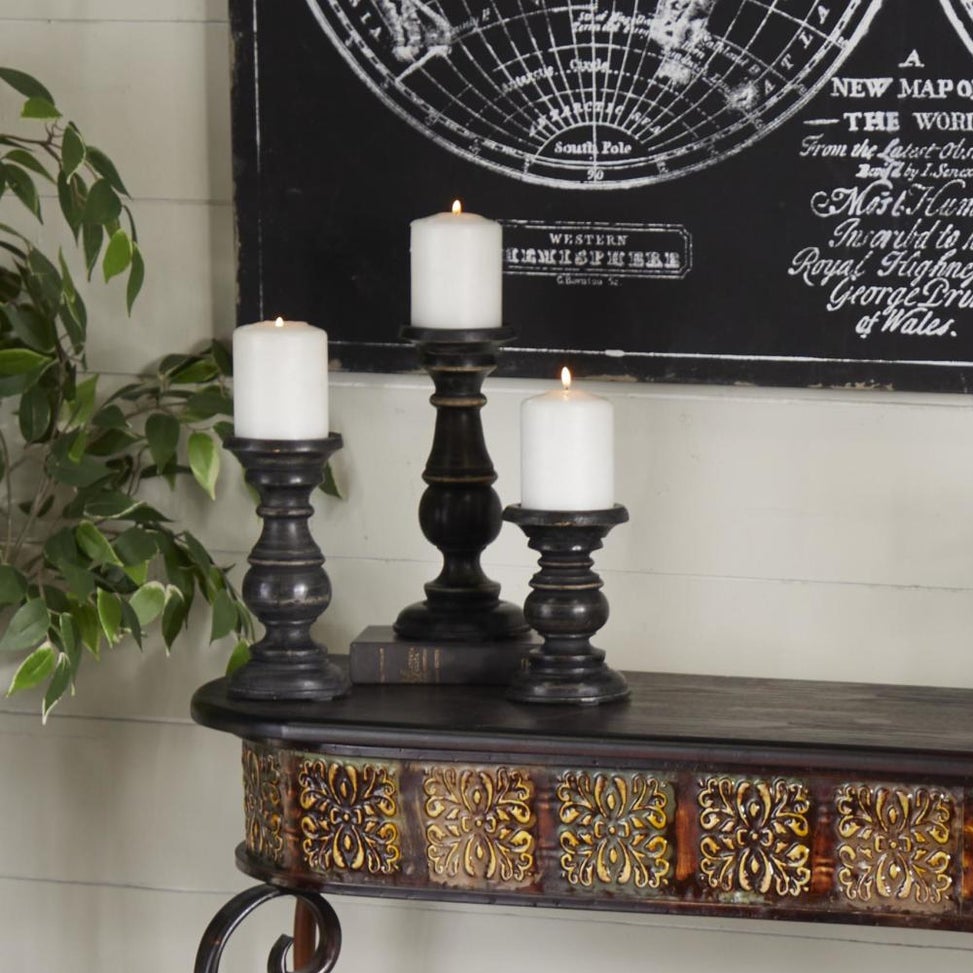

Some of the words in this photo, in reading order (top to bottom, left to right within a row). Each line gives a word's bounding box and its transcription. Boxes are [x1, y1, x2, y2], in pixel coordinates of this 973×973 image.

[898, 49, 925, 68] A
[830, 77, 894, 98] NEW
[897, 78, 954, 99] MAP
[843, 111, 900, 132] THE
[553, 140, 598, 156] South
[600, 140, 633, 155] Pole
[799, 133, 848, 157] From
[850, 138, 878, 160] the
[876, 137, 938, 162] Latest
[903, 163, 919, 182] by
[811, 179, 907, 218] Most
[549, 232, 629, 247] WESTERN
[935, 223, 961, 249] to
[787, 246, 875, 287] Royal
[826, 276, 922, 316] George
[854, 310, 883, 340] of
[881, 307, 958, 338] Wales.
